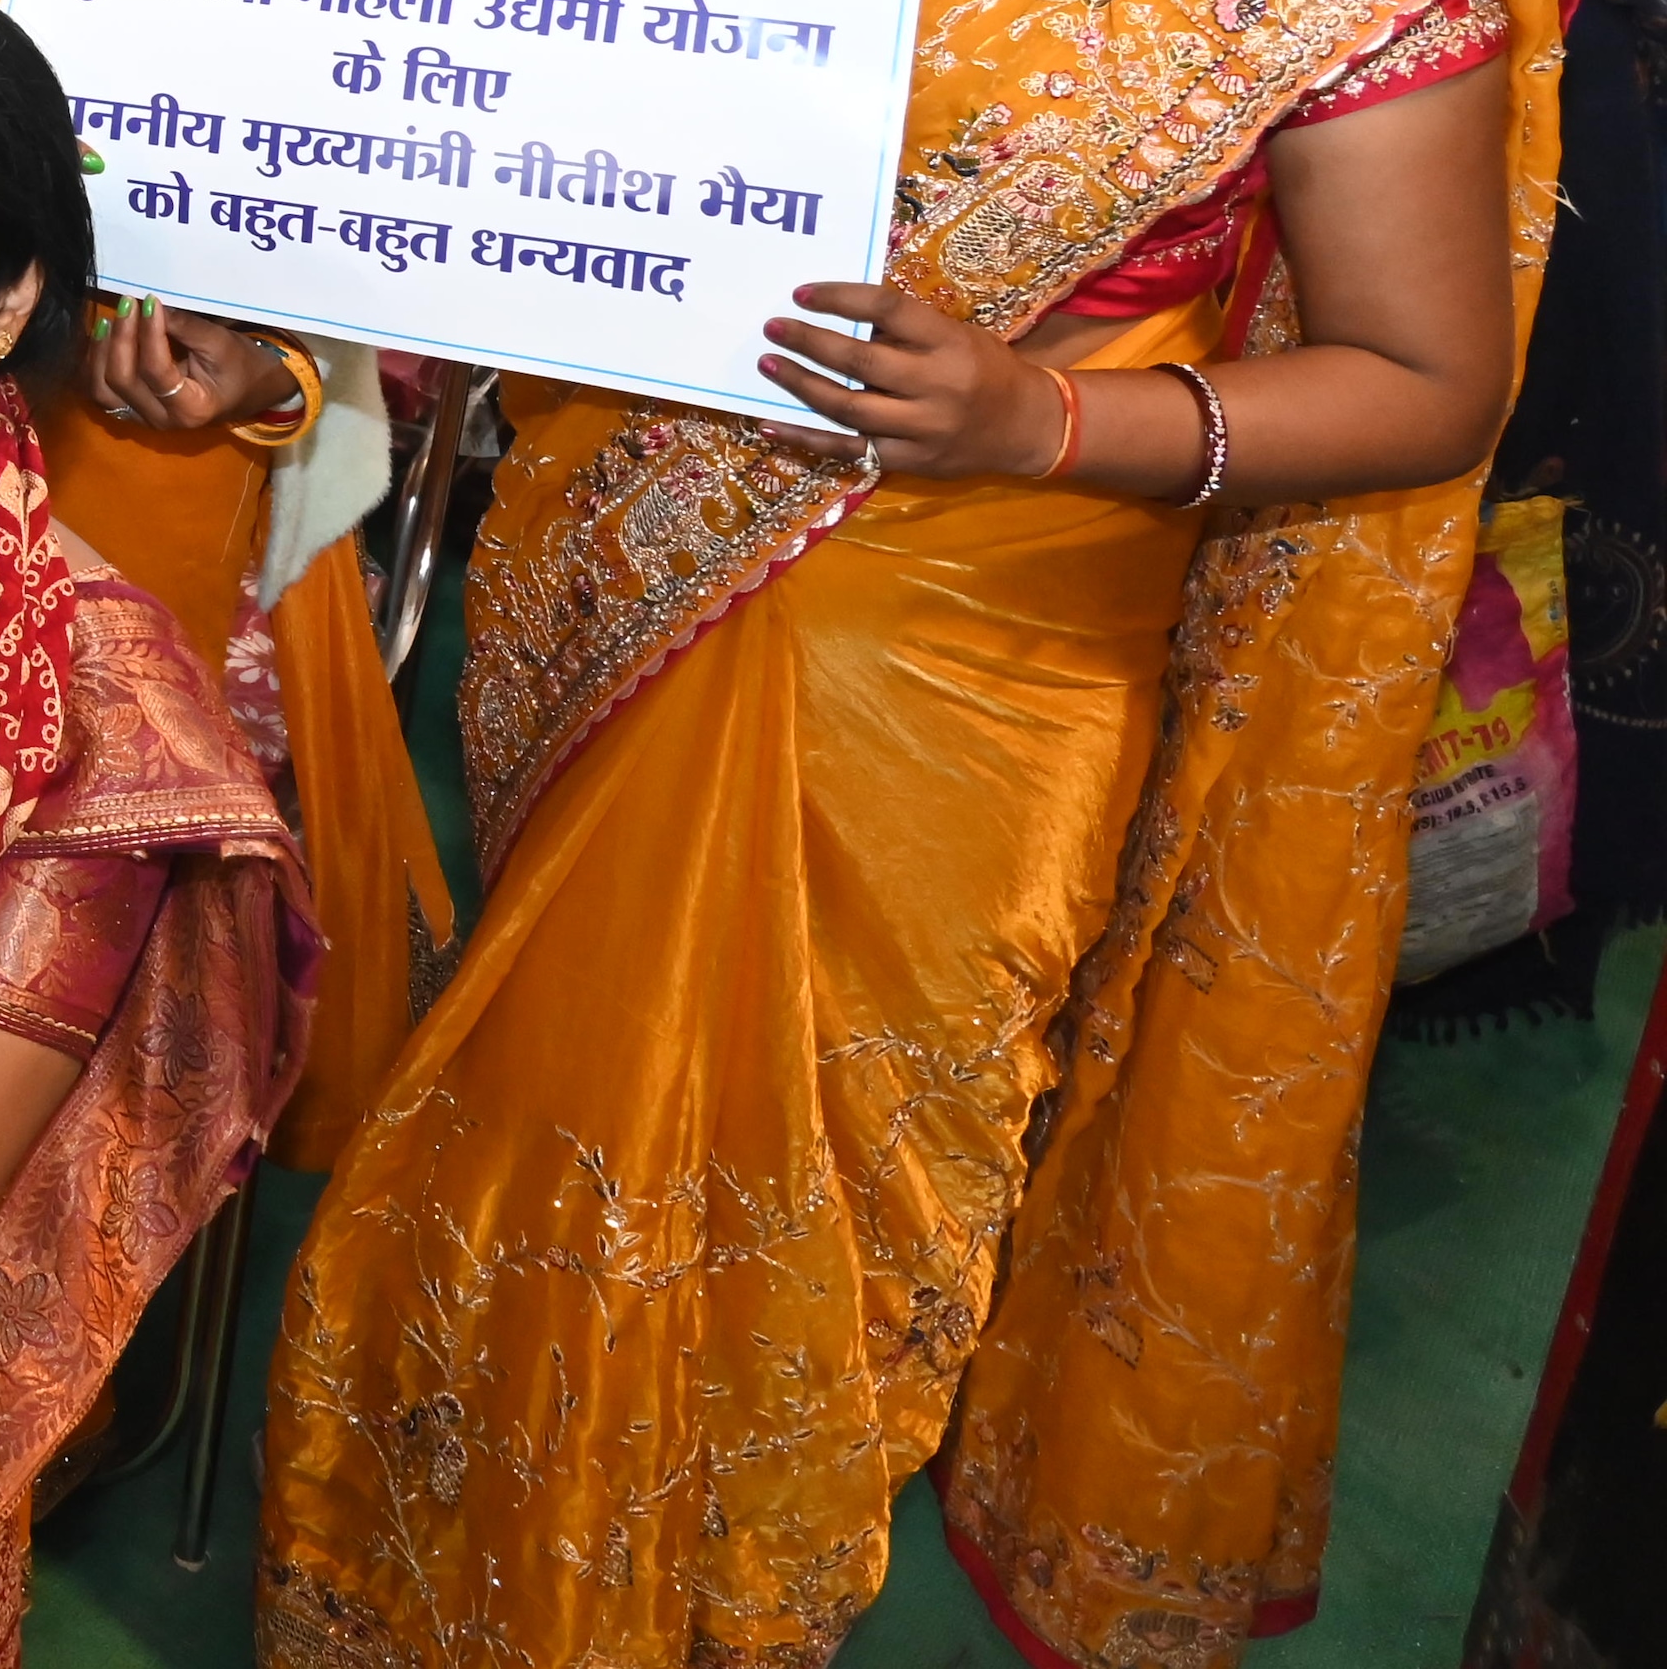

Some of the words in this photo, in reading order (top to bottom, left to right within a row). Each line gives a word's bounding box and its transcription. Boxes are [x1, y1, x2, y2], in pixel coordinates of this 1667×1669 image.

[332, 39, 386, 95] के
[402, 46, 512, 113] लिए
[71, 93, 226, 156] ाननीय
[242, 118, 477, 189] मुख्यमंत्री
[494, 141, 677, 216] नीतीश
[699, 165, 824, 236] भैया
[126, 170, 194, 225] को
[209, 190, 453, 270] बहुत-बहुत
[470, 229, 692, 303] धन्यवाद
